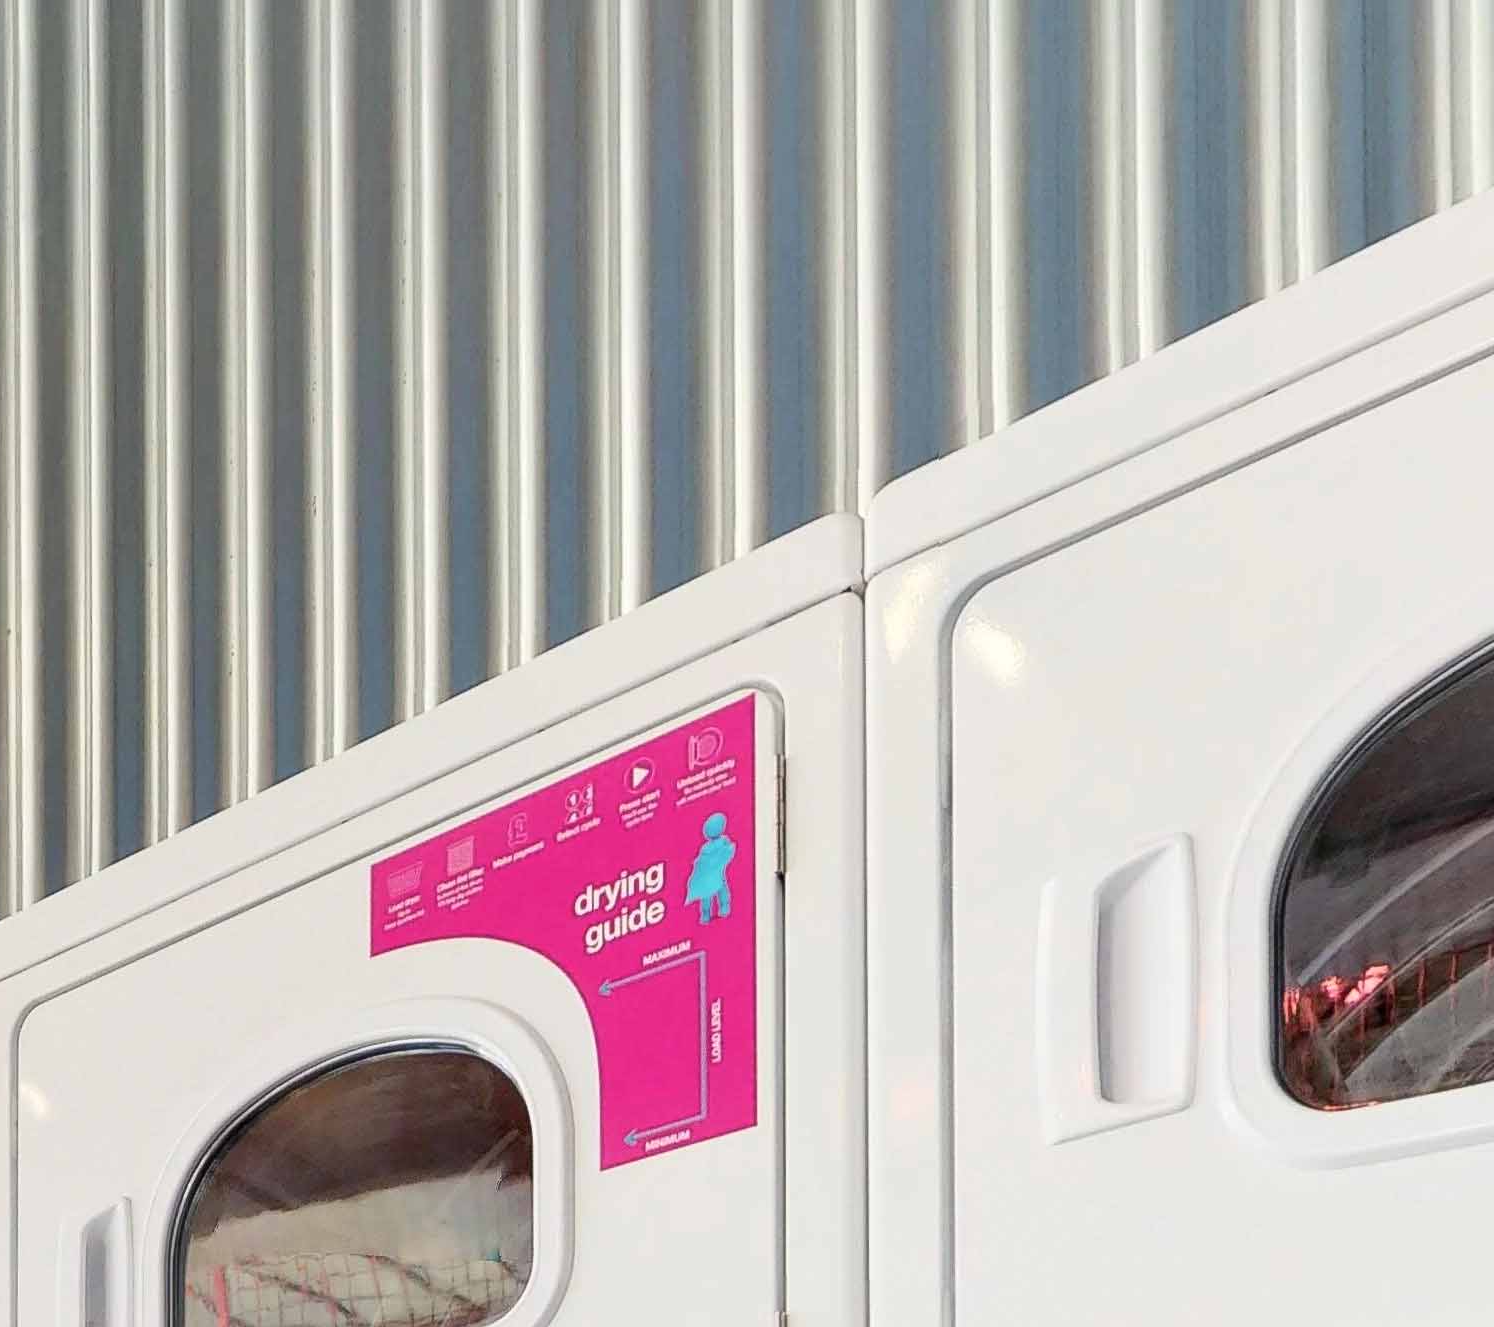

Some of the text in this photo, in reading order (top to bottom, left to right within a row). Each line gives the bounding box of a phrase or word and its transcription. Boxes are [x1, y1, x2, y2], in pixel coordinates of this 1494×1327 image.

[574, 862, 664, 917] drying
[584, 898, 665, 954] guide
[642, 940, 691, 967] MAXIMUM
[644, 1130, 690, 1152] MINIMUM
